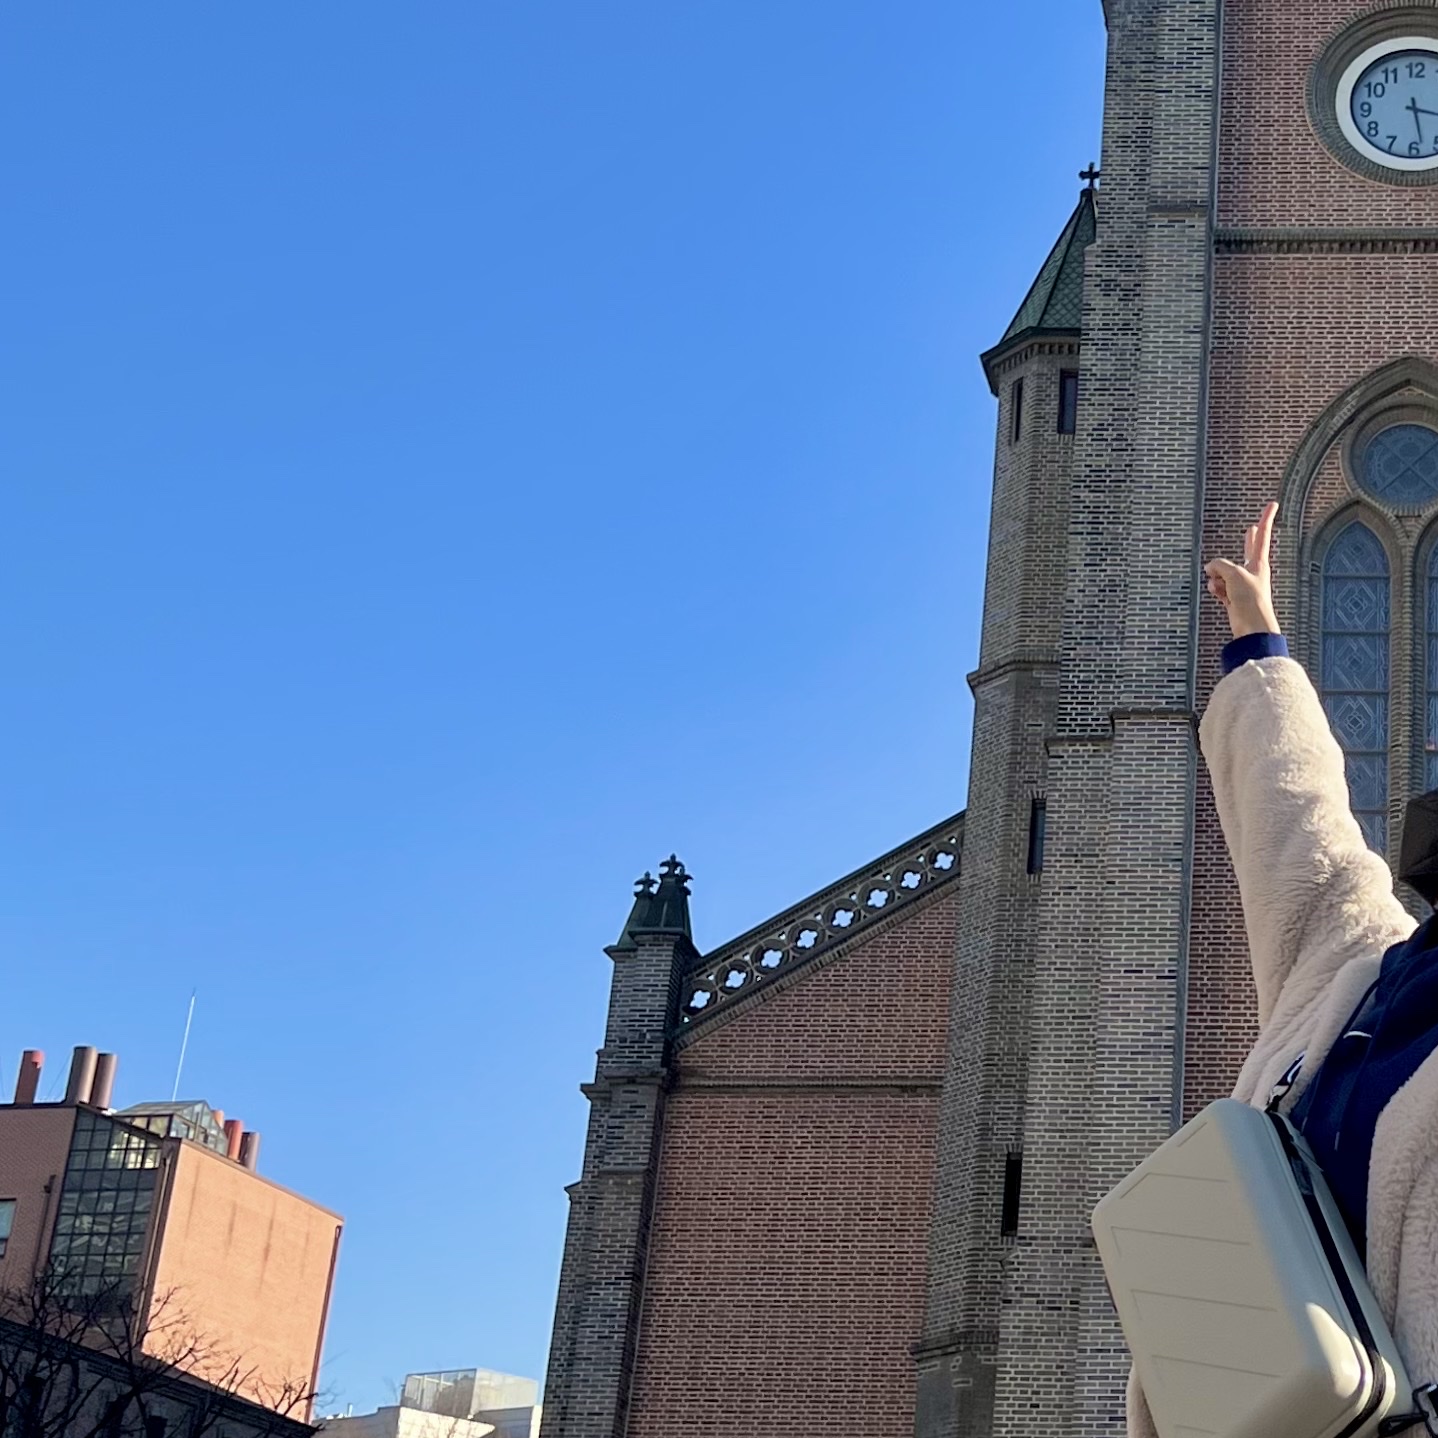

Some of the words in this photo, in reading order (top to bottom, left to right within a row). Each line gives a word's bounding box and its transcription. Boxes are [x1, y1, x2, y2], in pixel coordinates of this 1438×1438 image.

[1381, 67, 1399, 84] 11
[1405, 62, 1425, 79] 12
[1364, 82, 1385, 98] 10
[1359, 101, 1372, 118] 9
[1366, 121, 1379, 137] 8
[1386, 135, 1397, 151] 7
[1408, 141, 1420, 156] 6
